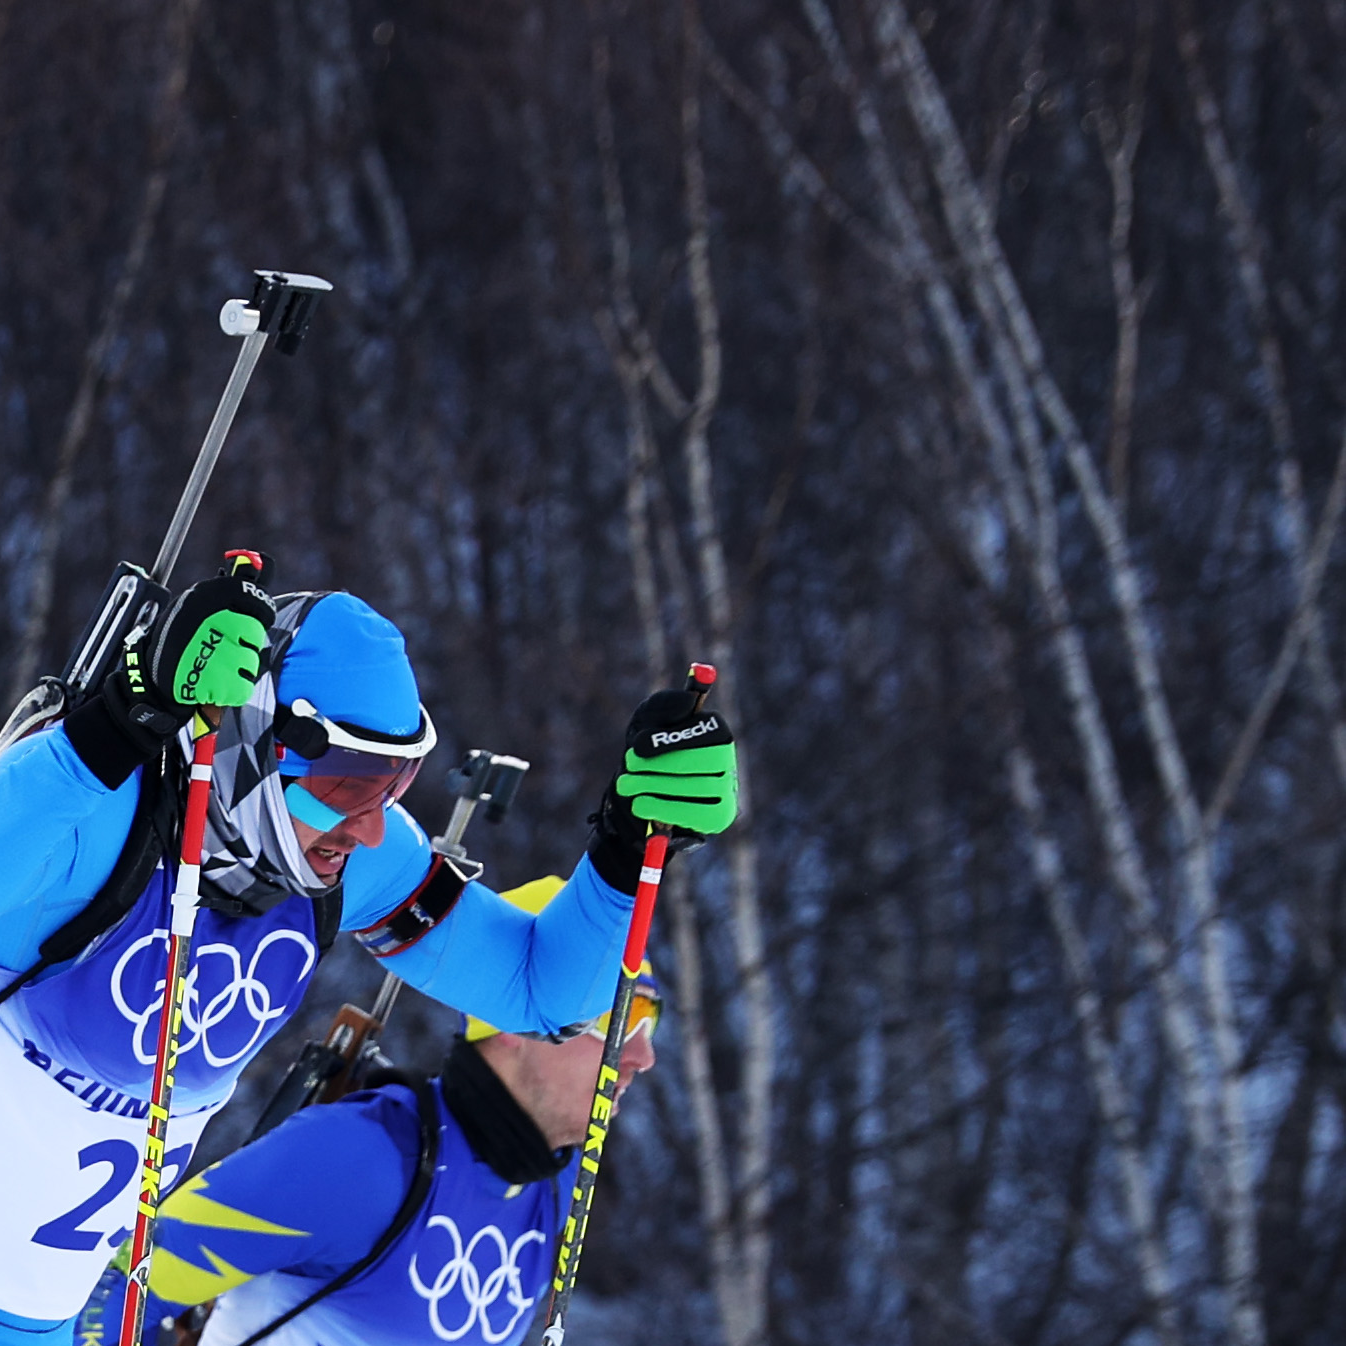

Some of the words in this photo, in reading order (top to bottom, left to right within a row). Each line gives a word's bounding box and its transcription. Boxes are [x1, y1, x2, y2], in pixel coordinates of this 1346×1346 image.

[125, 652, 146, 693] EKI
[23, 1037, 155, 1121] BEIJIN
[580, 1063, 619, 1174] LEKI
[138, 1102, 169, 1219] LEKI
